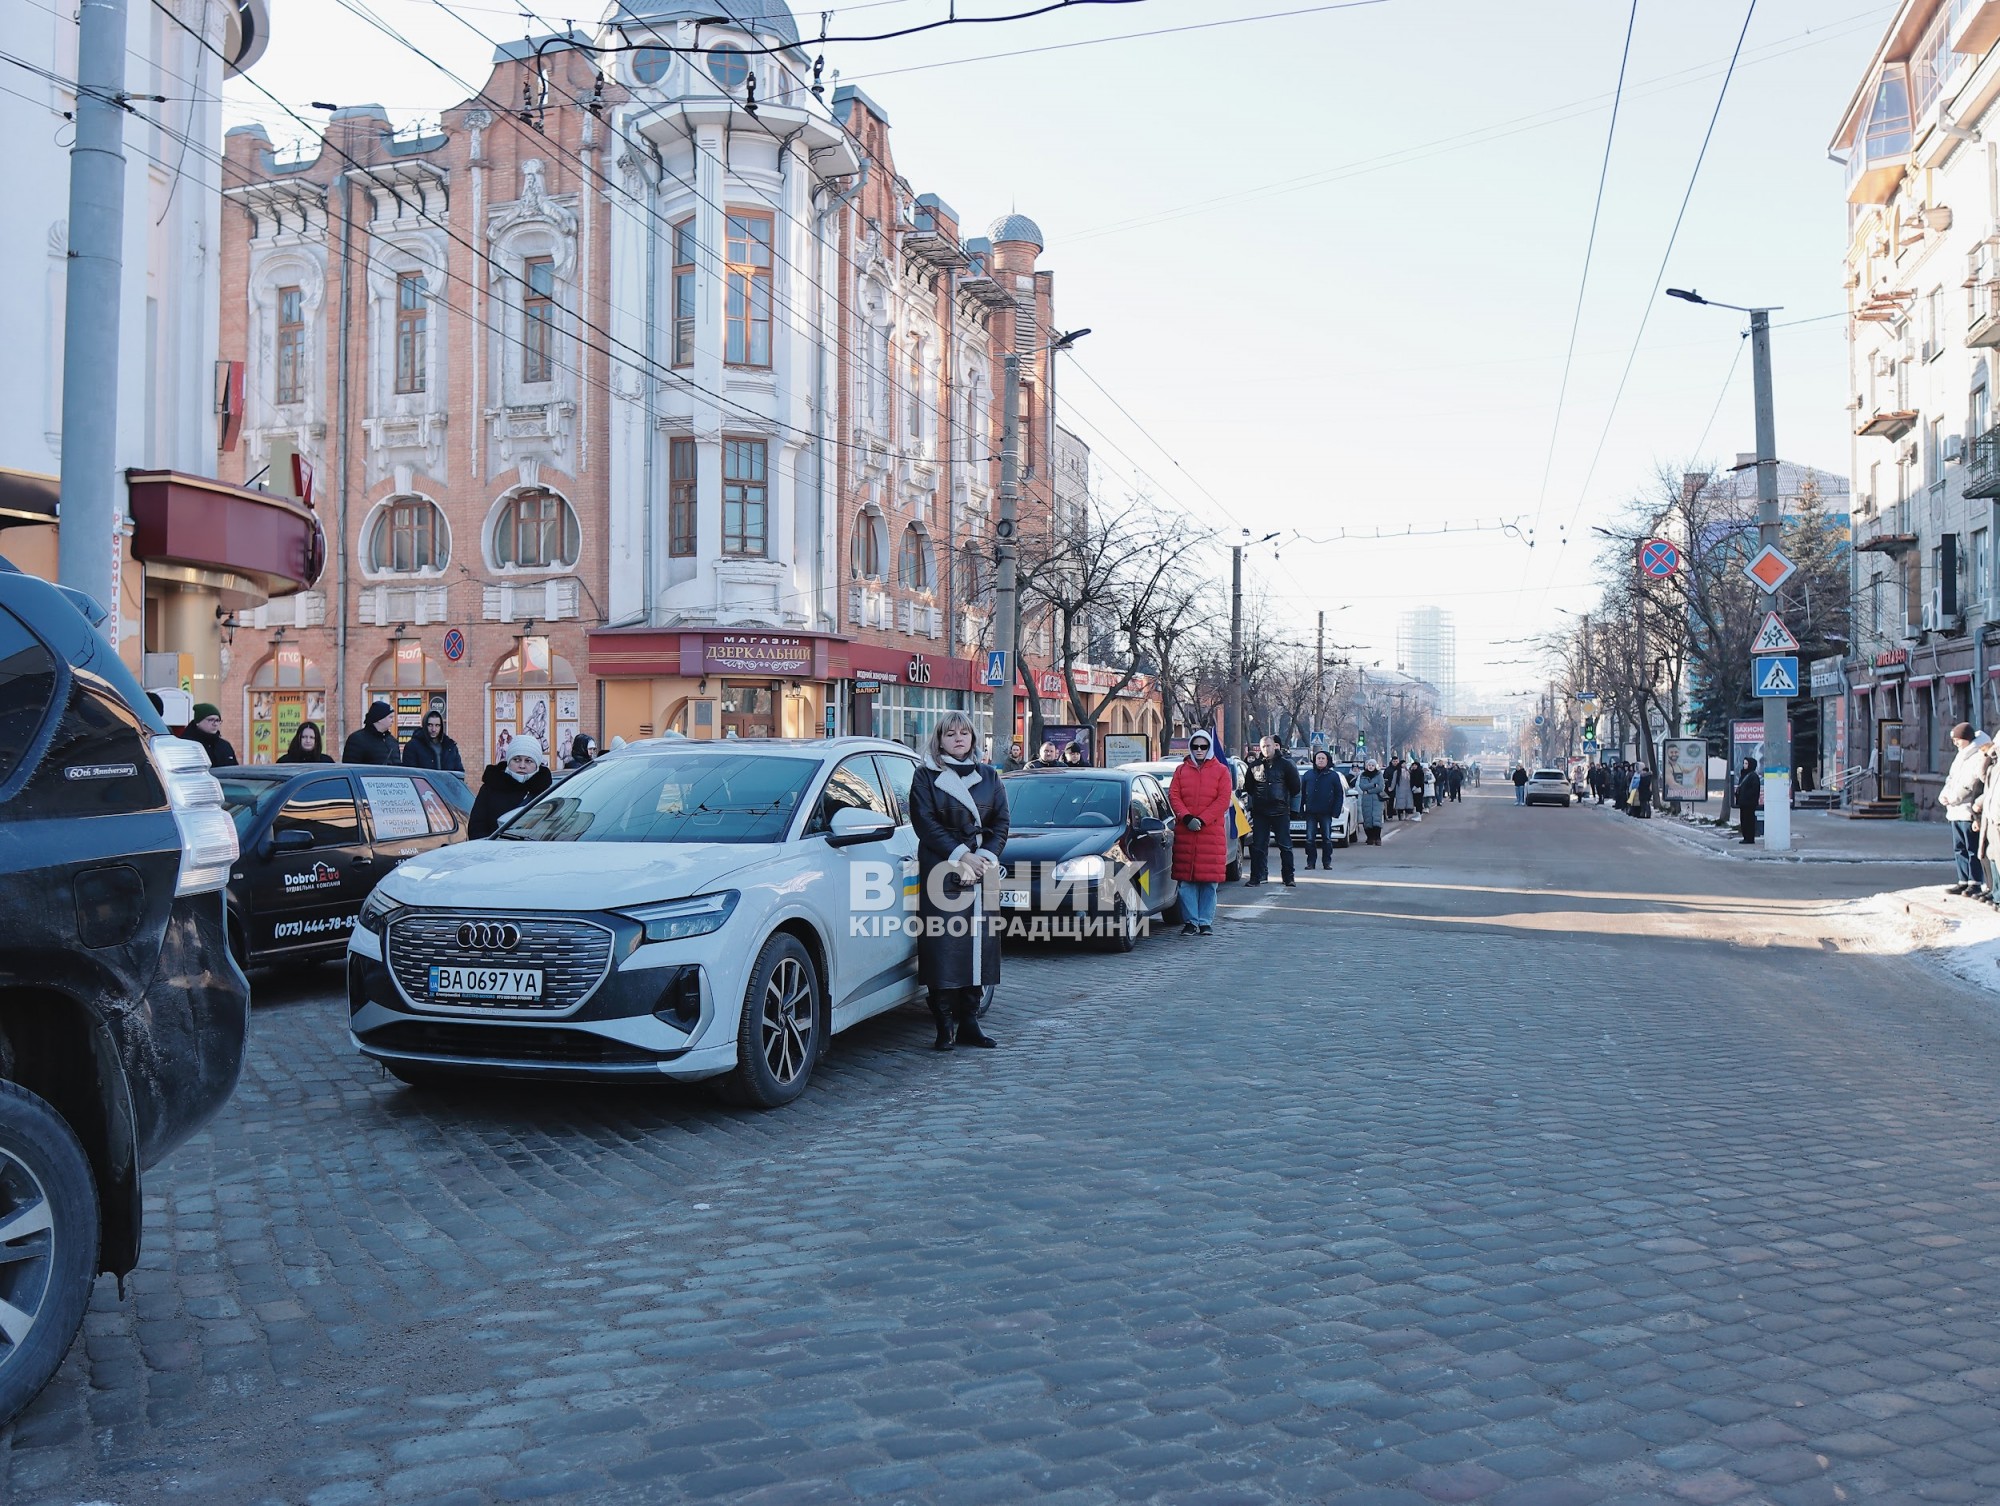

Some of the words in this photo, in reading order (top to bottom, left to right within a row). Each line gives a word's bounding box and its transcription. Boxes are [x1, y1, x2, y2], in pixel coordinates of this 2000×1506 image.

[723, 636, 800, 646] МАГАЗИН
[705, 645, 812, 661] ДЗЕРКАЛЬНИЙ
[908, 653, 931, 684] elis
[69, 768, 91, 778] 60th
[92, 767, 134, 775] Anniversary
[274, 920, 303, 939] (073)
[303, 914, 360, 933] 444-78-83
[439, 969, 463, 990] BA
[467, 971, 509, 991] 0697
[513, 973, 537, 993] YA
